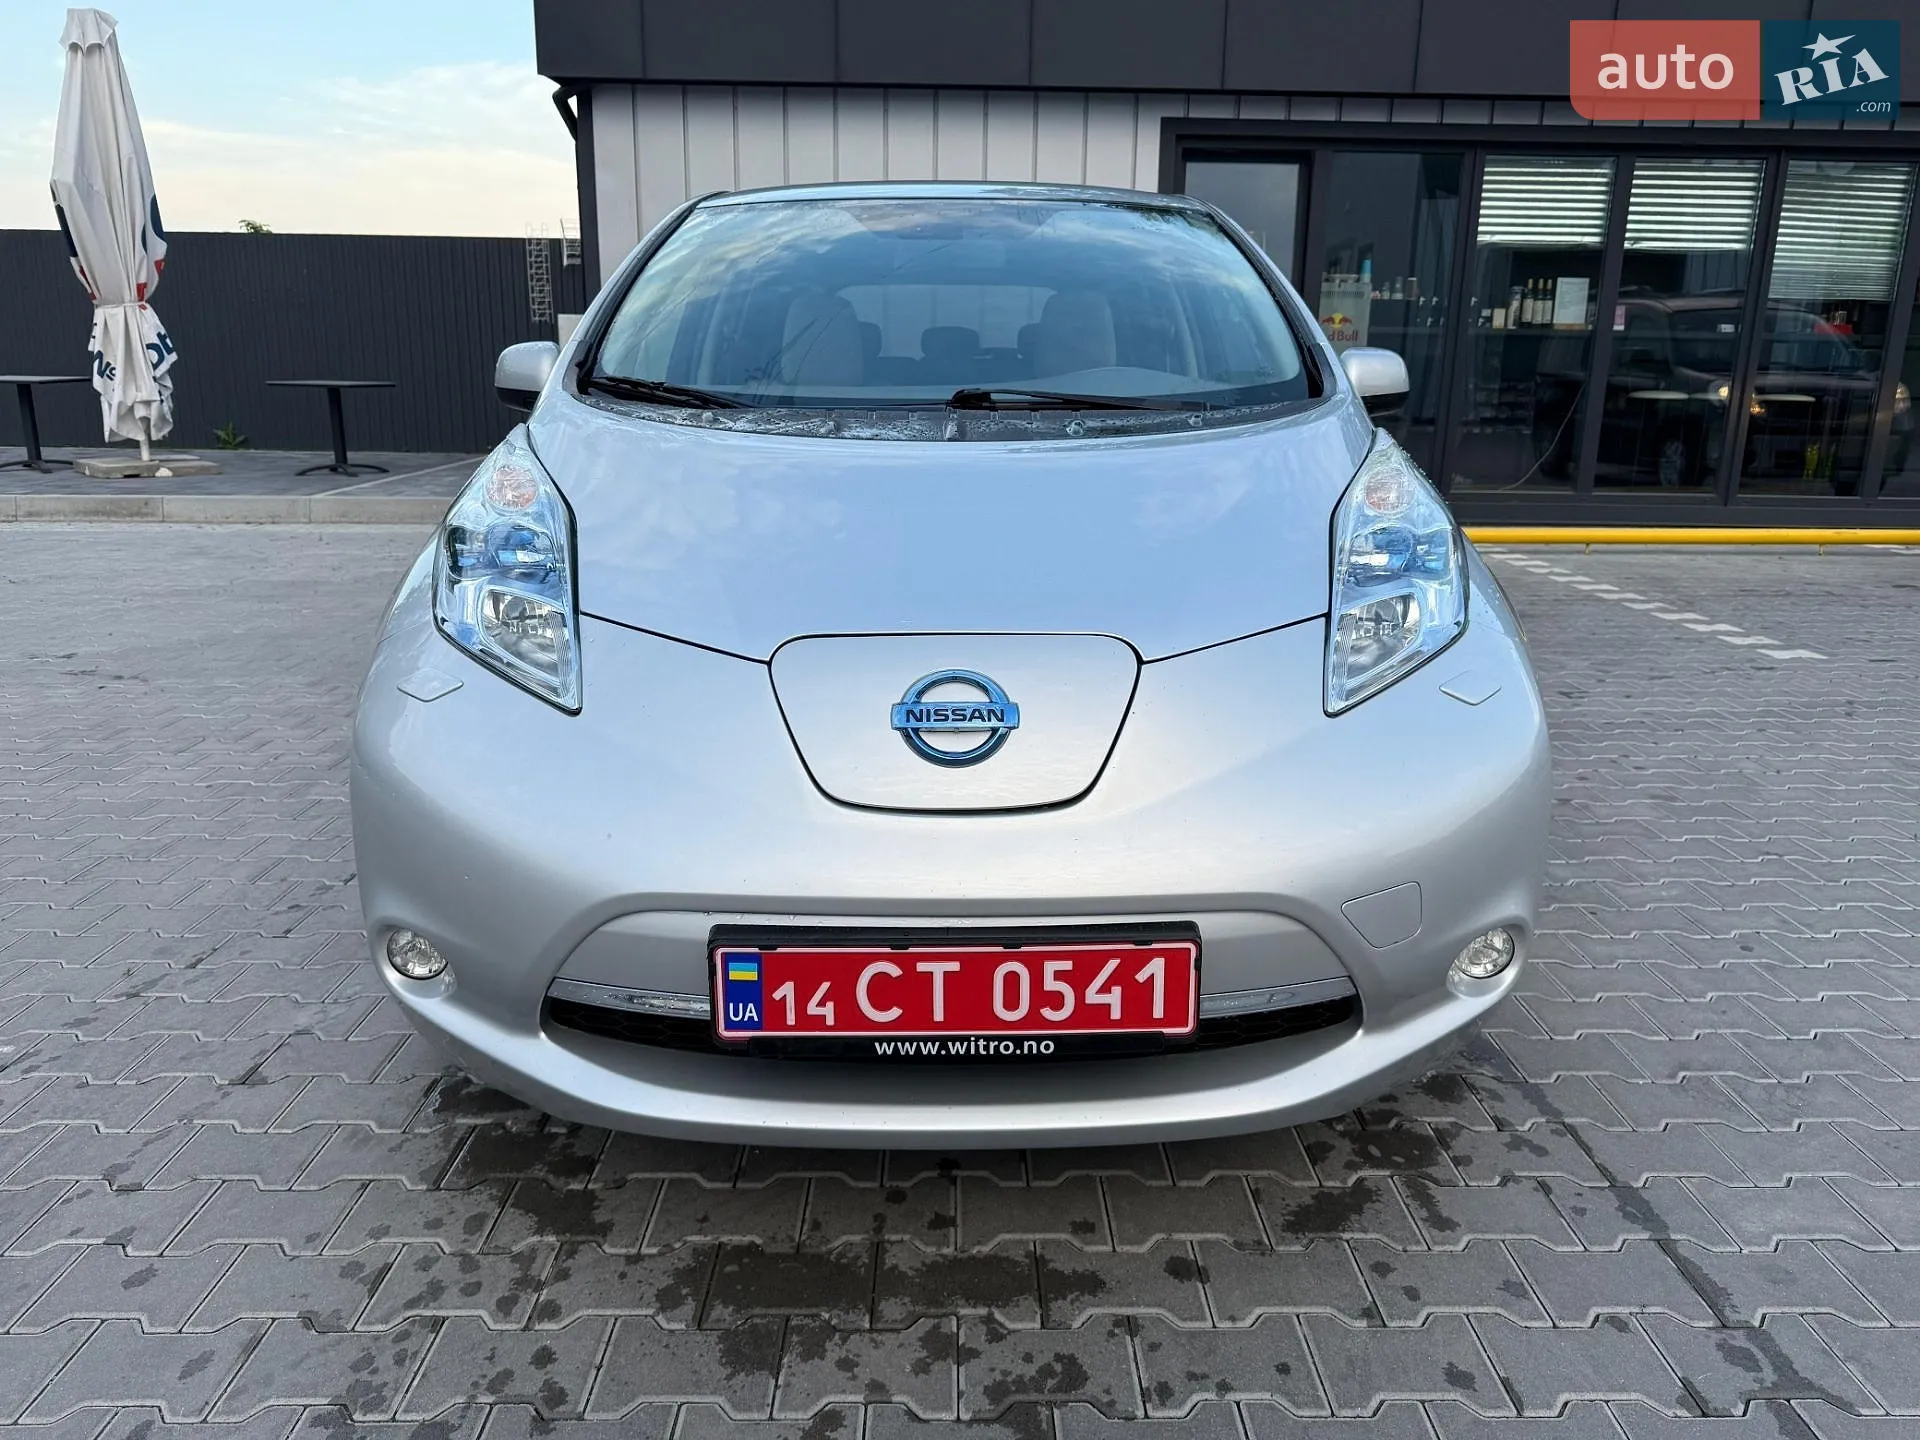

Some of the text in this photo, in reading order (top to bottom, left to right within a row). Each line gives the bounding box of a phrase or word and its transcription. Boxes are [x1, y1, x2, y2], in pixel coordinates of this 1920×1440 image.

[905, 708, 1005, 723] NISSAN
[772, 957, 1165, 1026] 14 CT 0541
[729, 1002, 759, 1022] UA
[874, 1036, 1055, 1056] www.witro.no
